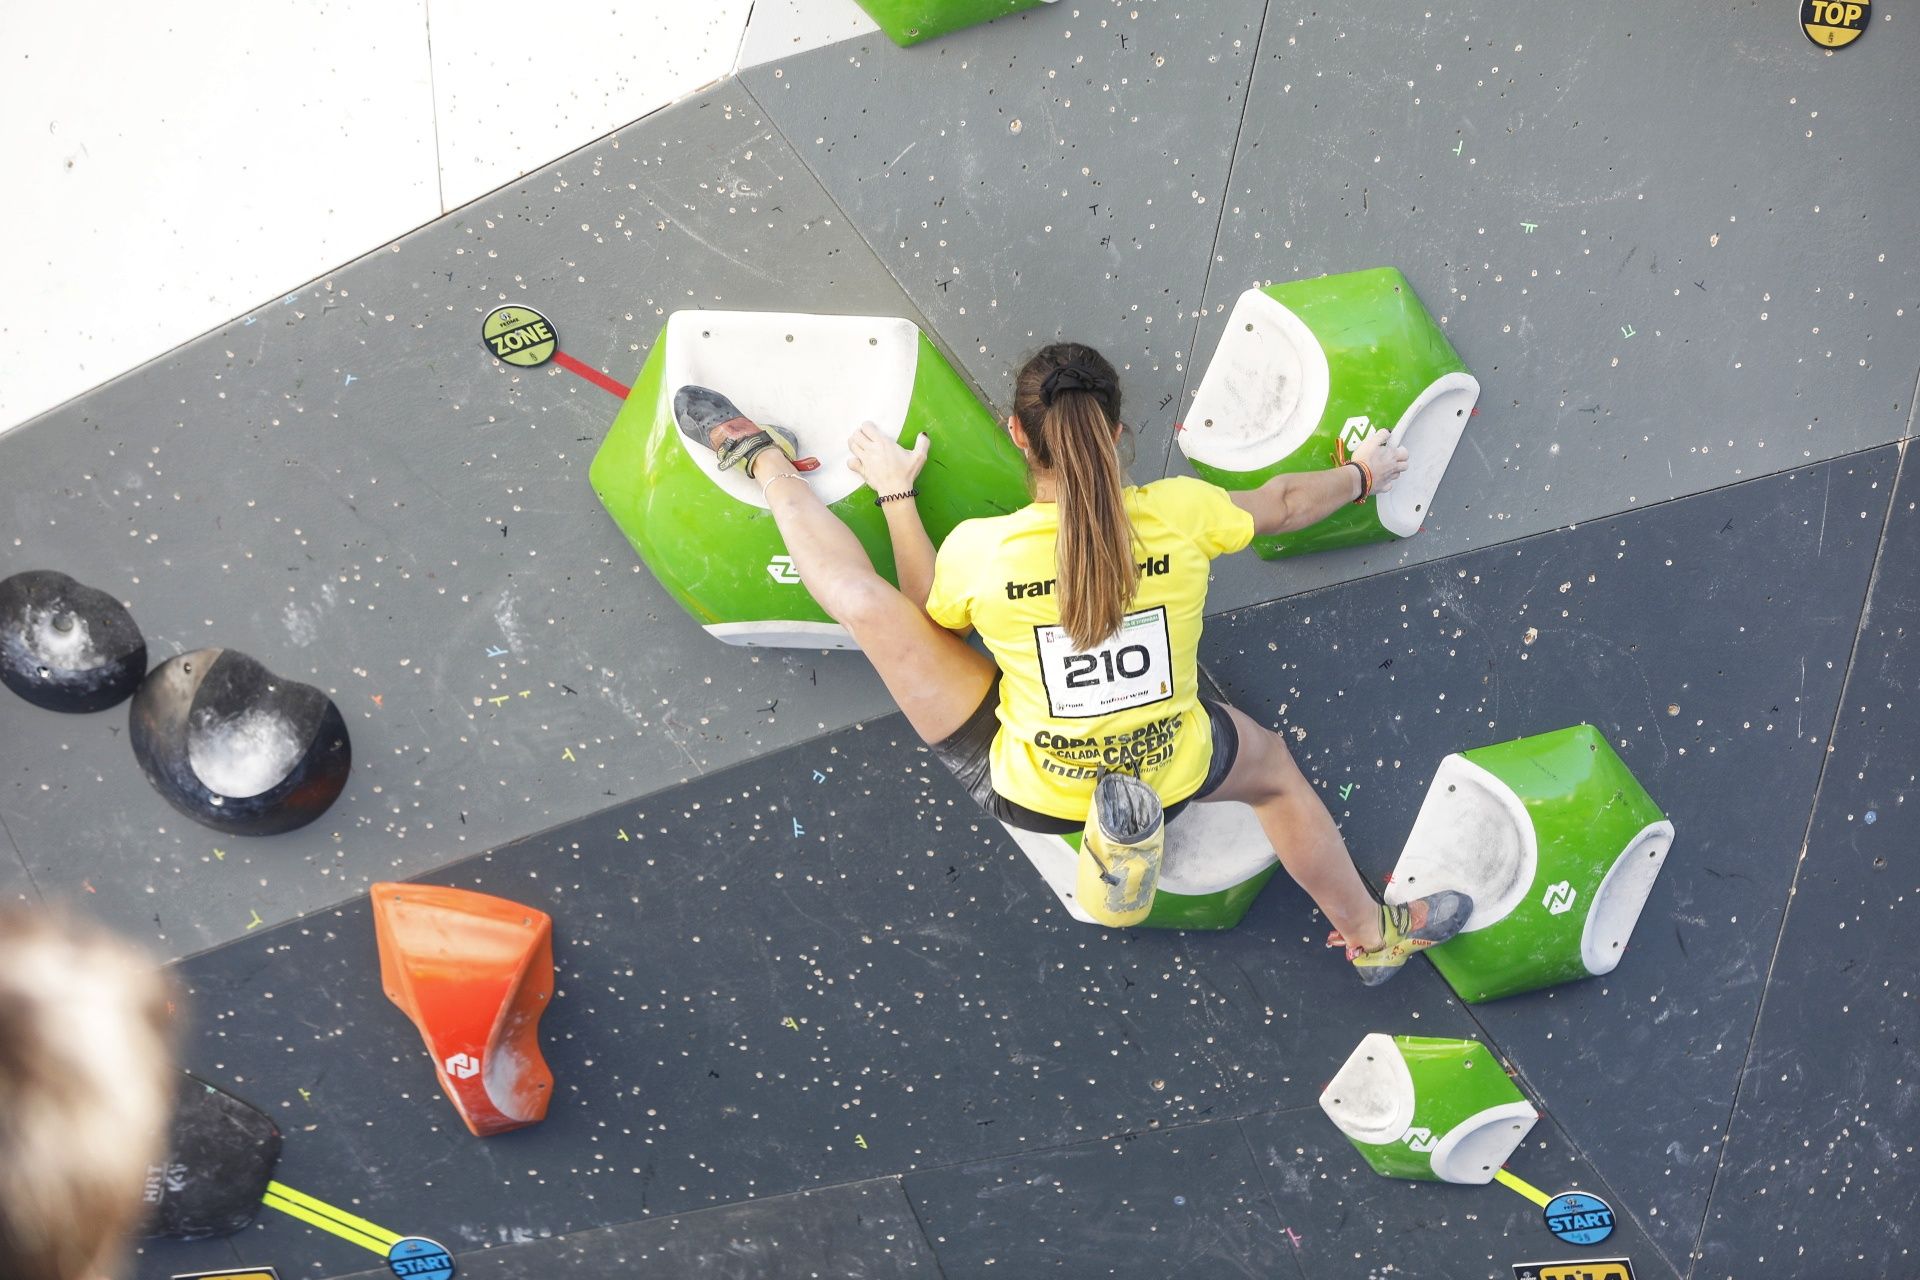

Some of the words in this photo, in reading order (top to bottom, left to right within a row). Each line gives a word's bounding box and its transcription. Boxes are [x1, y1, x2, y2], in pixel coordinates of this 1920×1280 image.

[1812, 0, 1862, 26] TOP
[490, 322, 553, 356] ZONE
[1063, 645, 1151, 689] 210
[1034, 730, 1098, 750] COPA
[1548, 1211, 1611, 1232] START
[393, 1254, 451, 1275] START
